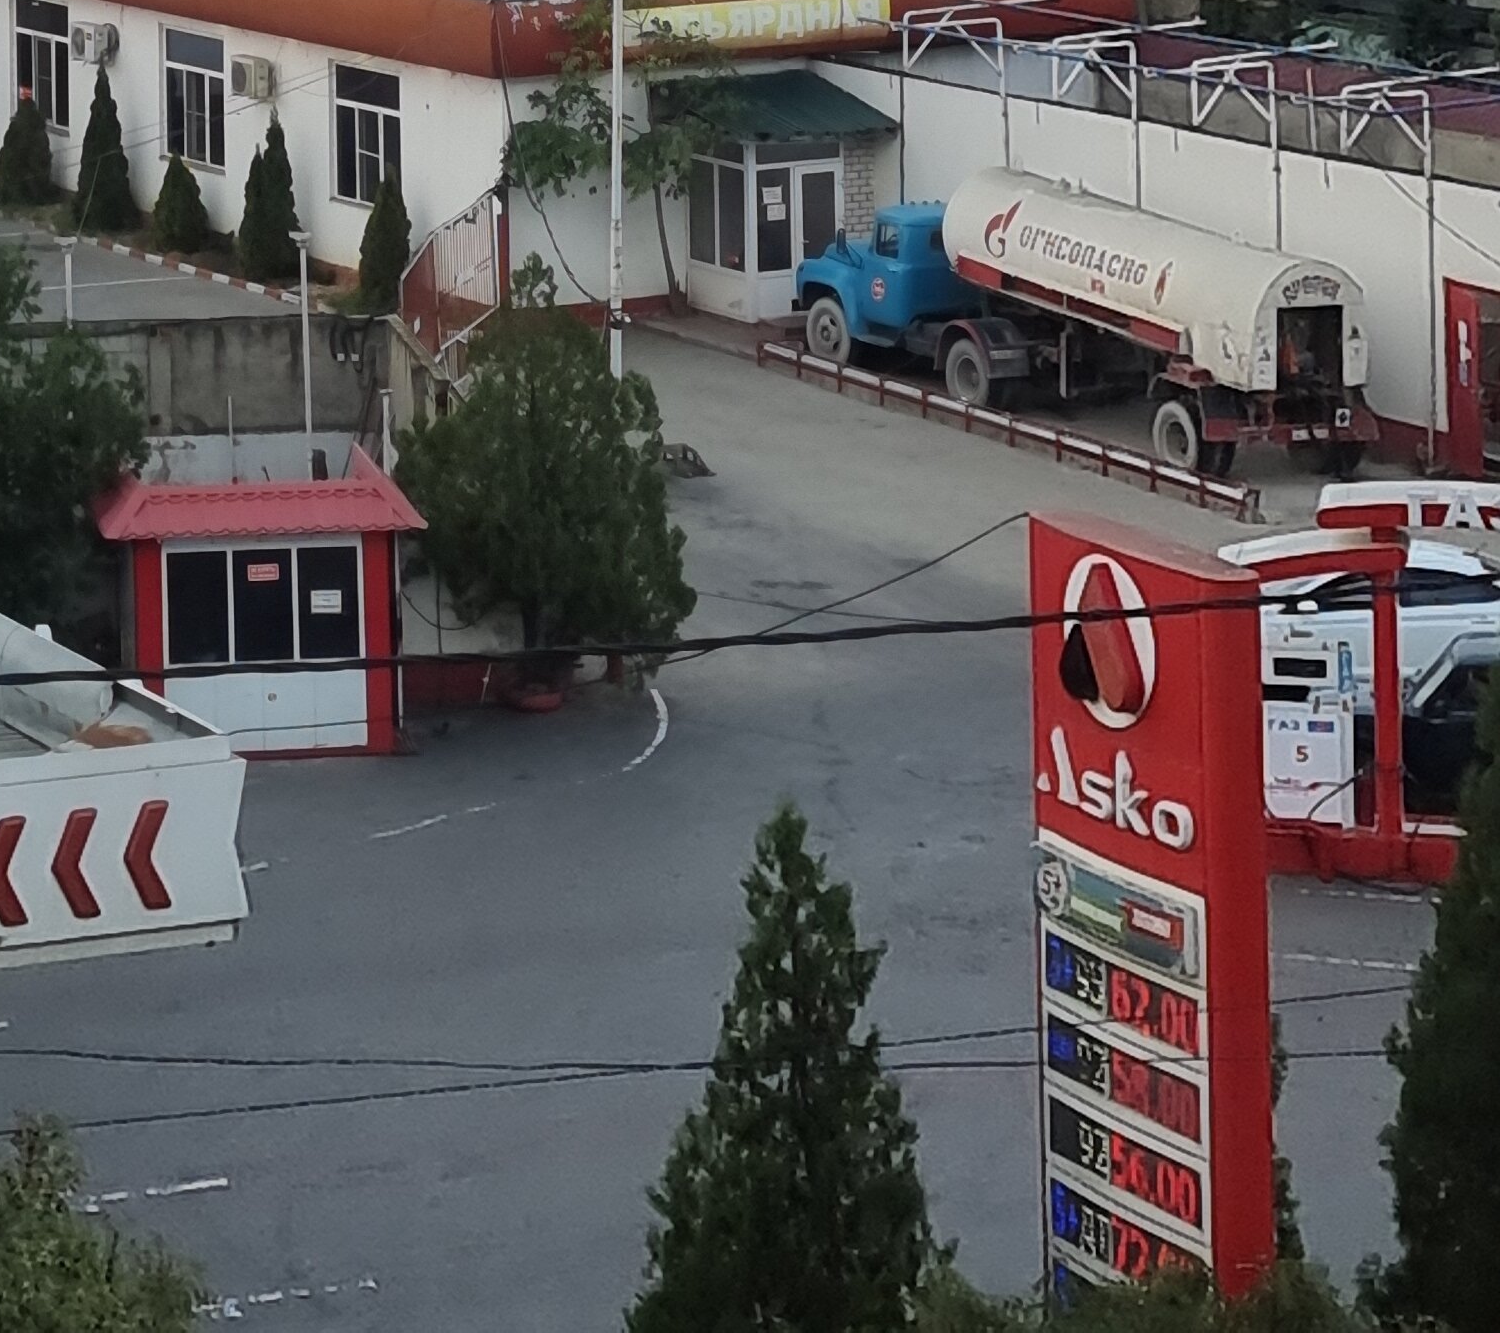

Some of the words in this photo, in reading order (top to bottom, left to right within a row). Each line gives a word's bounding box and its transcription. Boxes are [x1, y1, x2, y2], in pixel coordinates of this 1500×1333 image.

[1019, 225, 1148, 286] ОГНЕОПАСНО
[1407, 488, 1500, 532] ГА
[1295, 745, 1309, 763] 5
[1036, 725, 1195, 851] Asko
